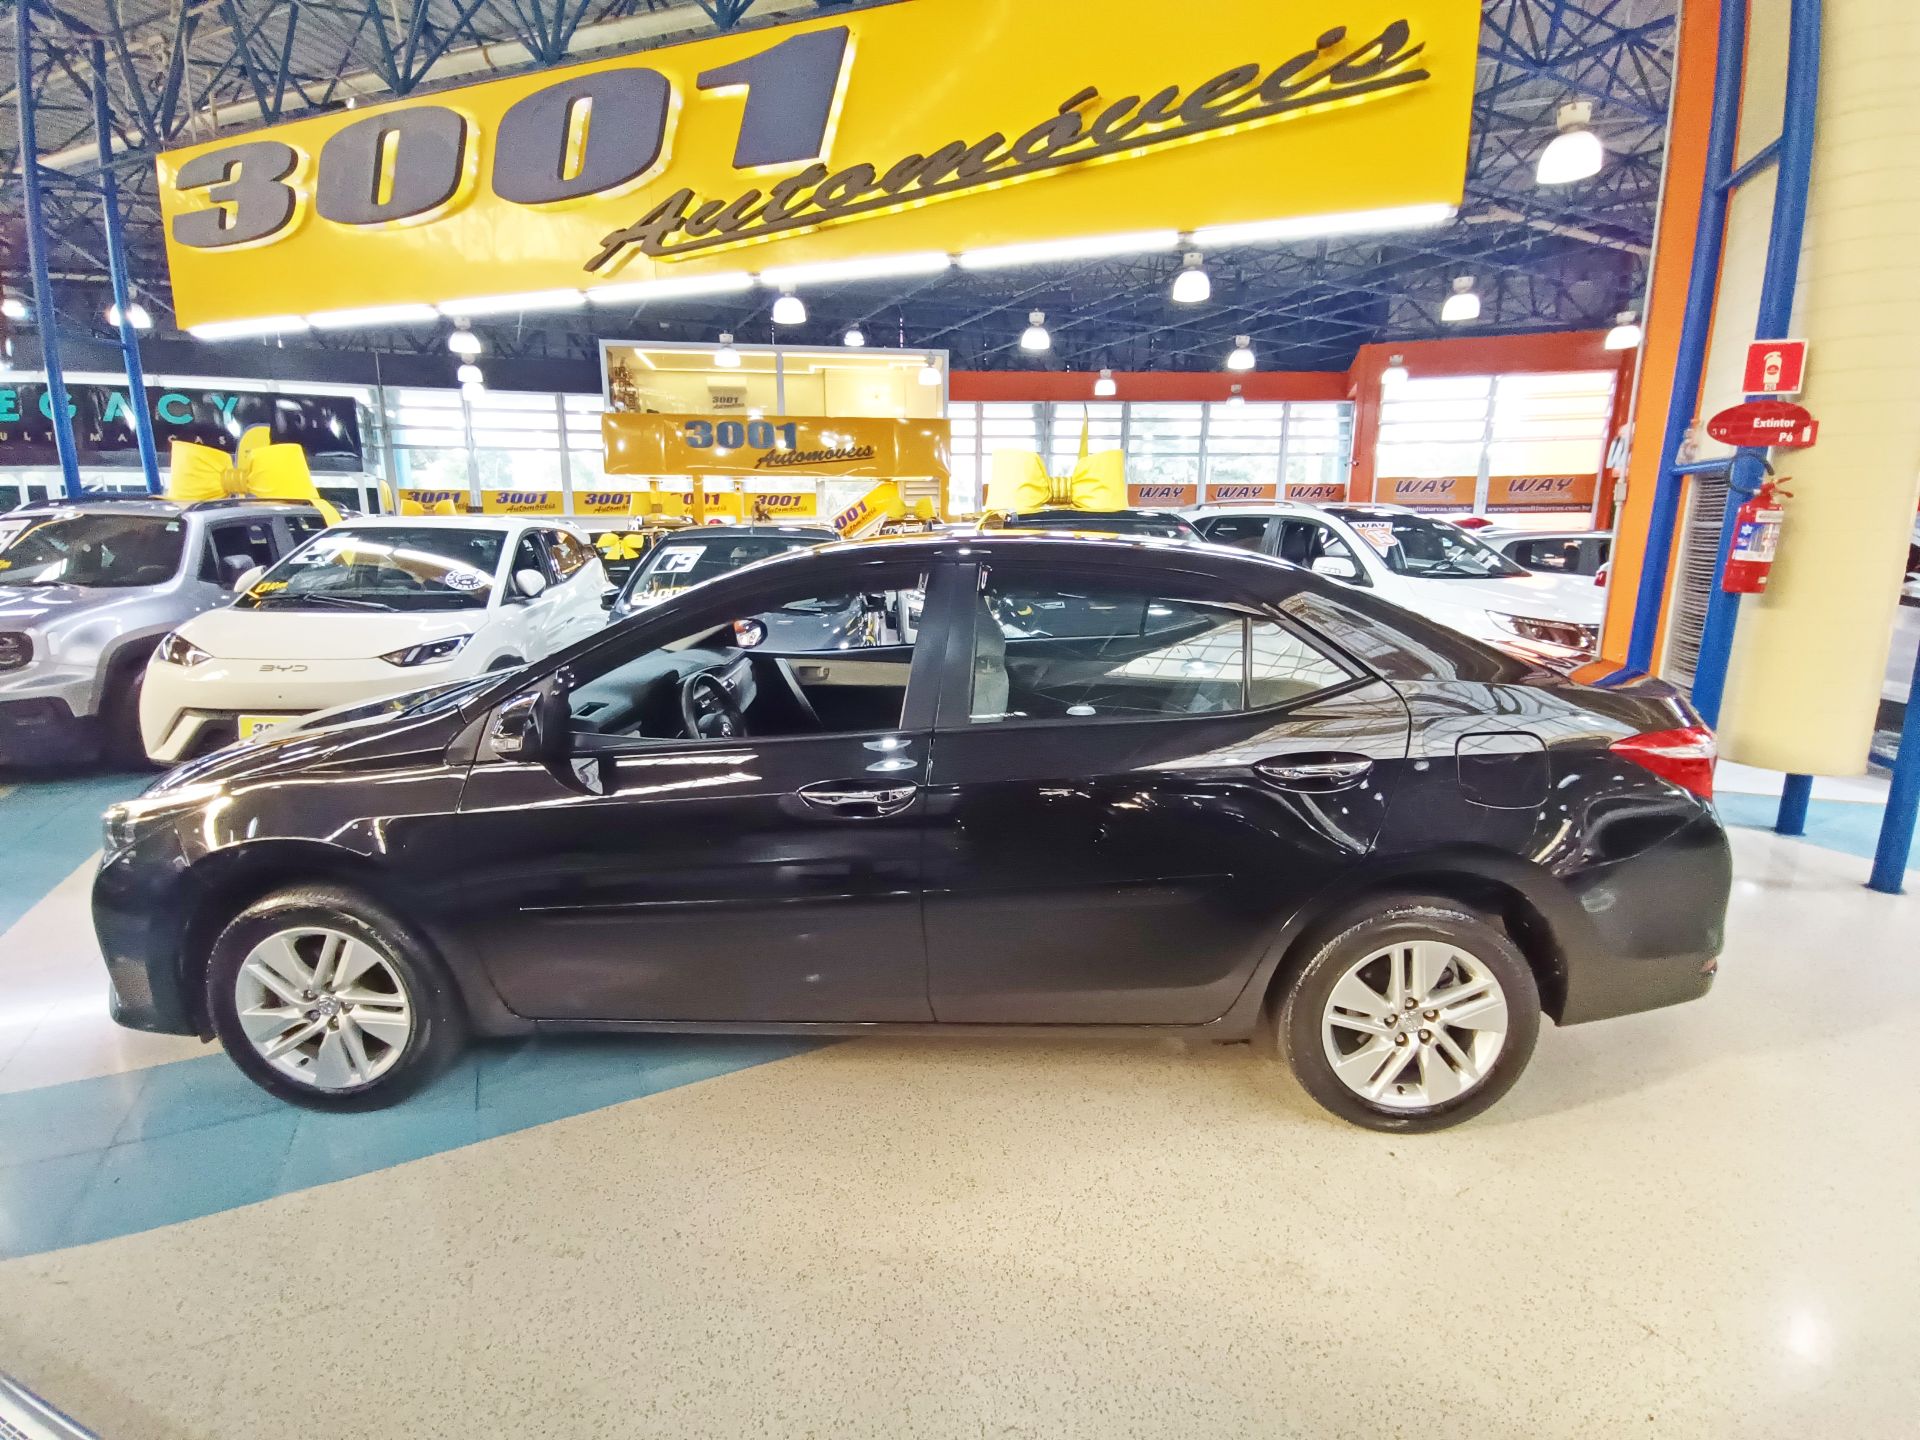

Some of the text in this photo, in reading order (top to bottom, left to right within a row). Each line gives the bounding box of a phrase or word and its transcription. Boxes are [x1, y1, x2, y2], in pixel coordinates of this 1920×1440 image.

[172, 25, 850, 249] 3001
[583, 19, 1430, 272] Automóveis
[1753, 417, 1795, 428] Extintor
[684, 420, 797, 450] 3001
[754, 445, 875, 469] Automóveis
[1395, 479, 1456, 493] WAY
[1508, 477, 1575, 492] WAY
[496, 492, 548, 504] 3001
[1139, 487, 1184, 498] WAY
[1216, 486, 1264, 498] WAY
[1290, 486, 1337, 498] WAY
[757, 495, 802, 506] 3001
[259, 664, 308, 672] BYD
